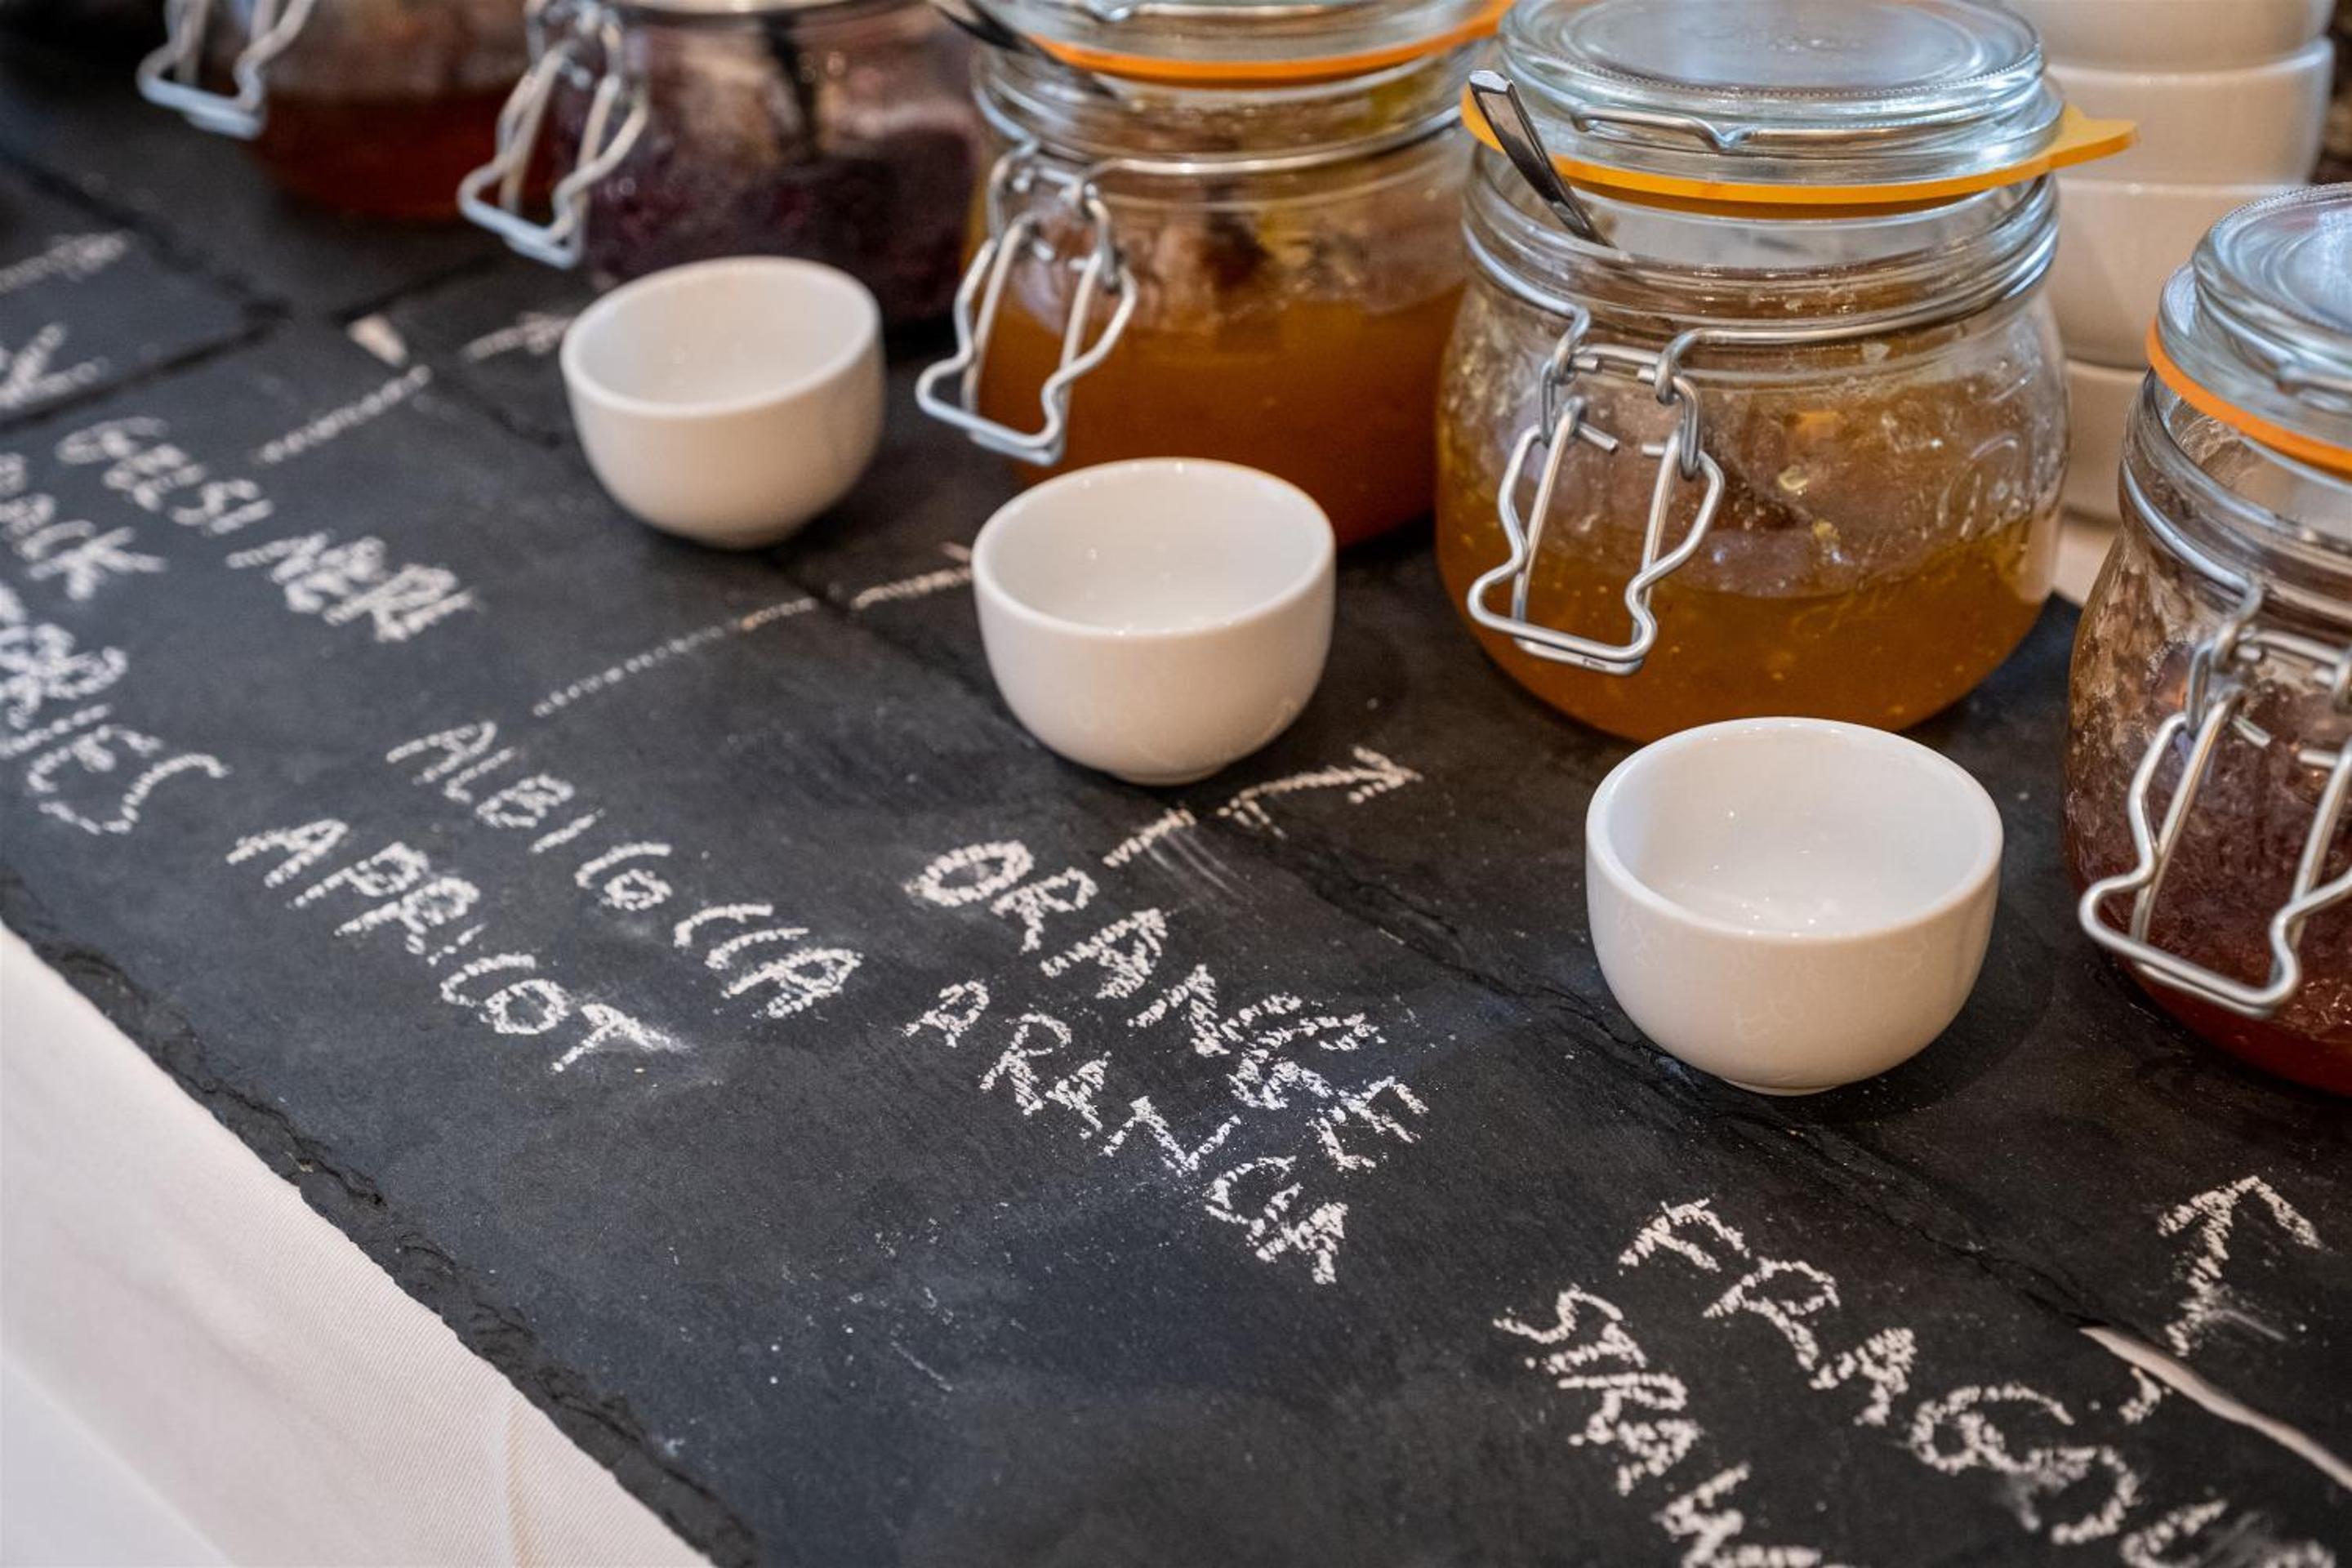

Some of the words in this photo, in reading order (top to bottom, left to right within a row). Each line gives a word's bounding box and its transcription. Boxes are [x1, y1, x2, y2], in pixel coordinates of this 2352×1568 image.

[225, 529, 475, 642] NERI
[226, 818, 679, 1072] APRICOT
[386, 720, 863, 1019] ALBICOCCA
[902, 840, 1429, 1172] ORANGE
[902, 979, 1350, 1285] ARANCIA
